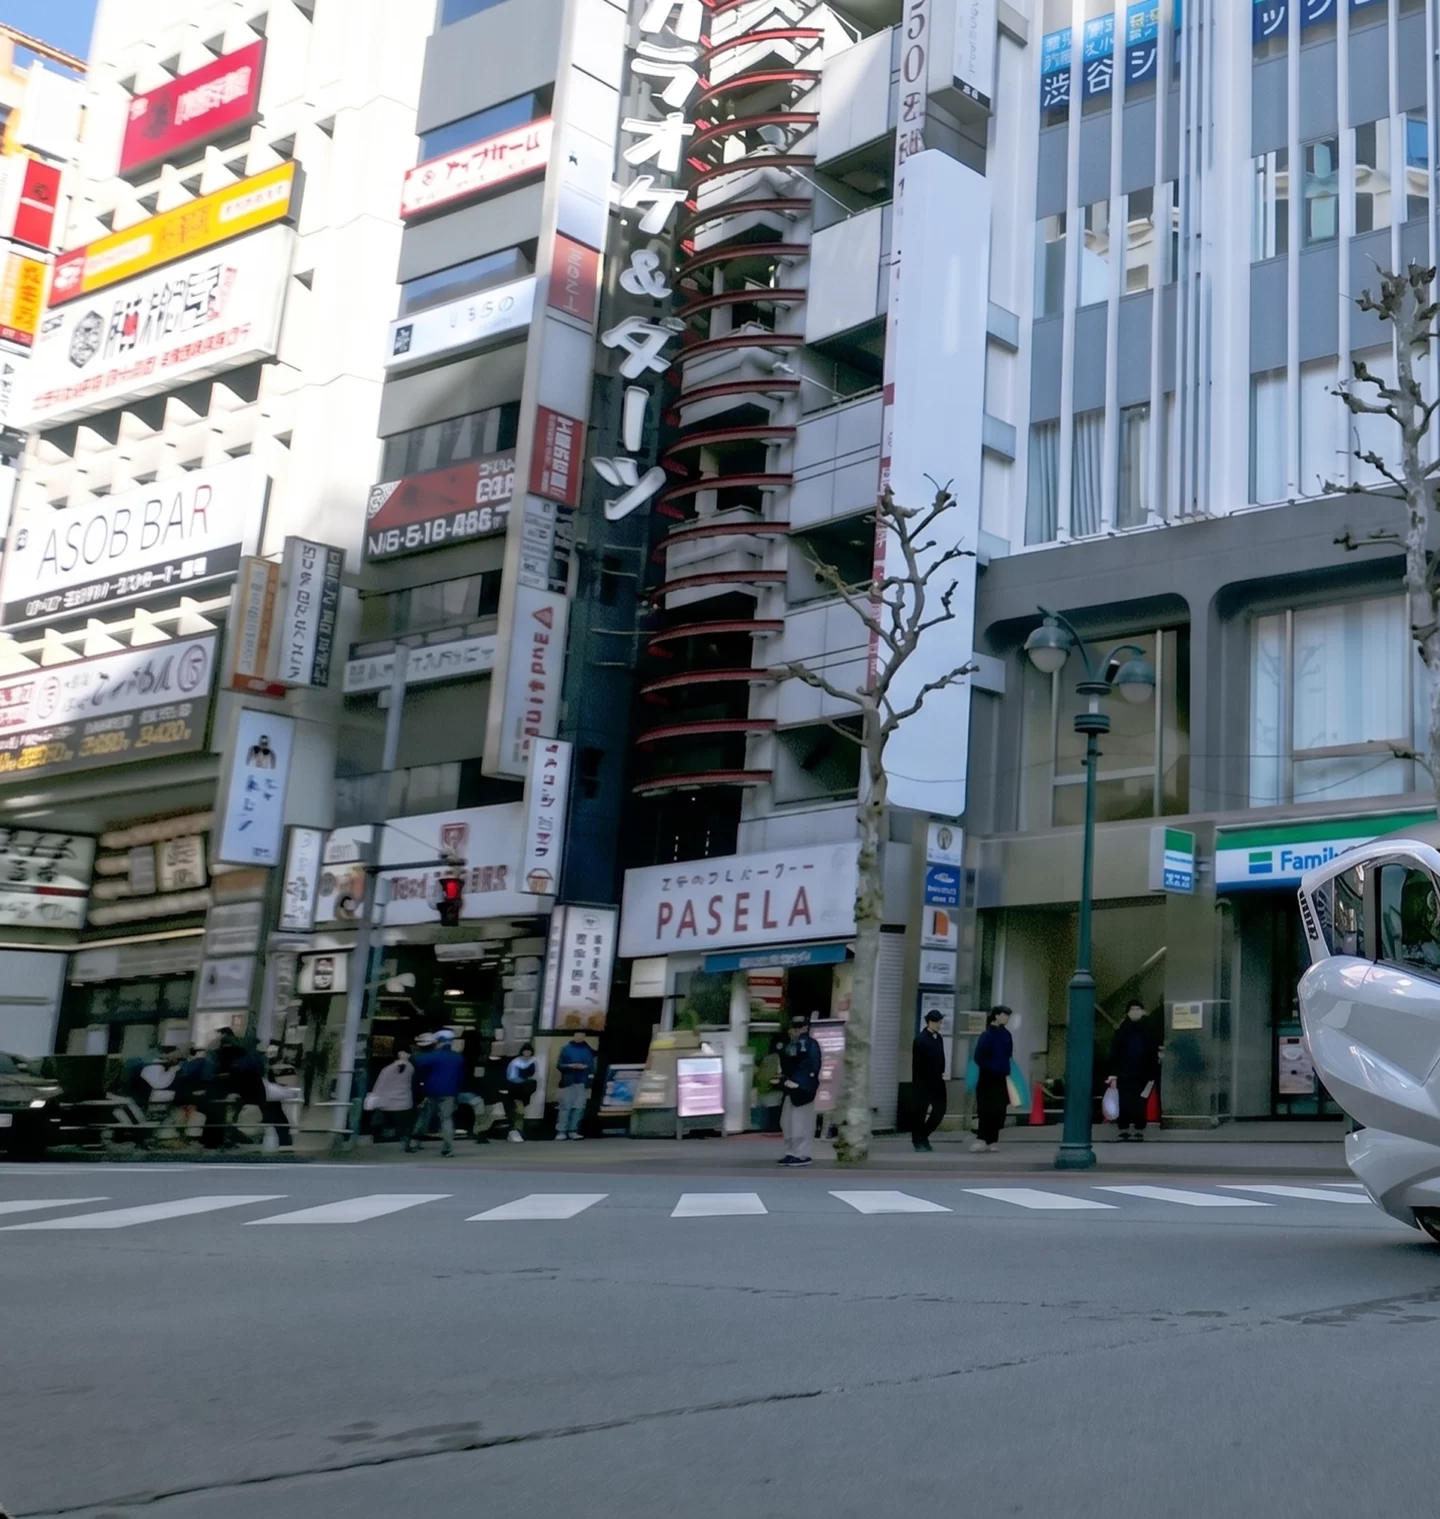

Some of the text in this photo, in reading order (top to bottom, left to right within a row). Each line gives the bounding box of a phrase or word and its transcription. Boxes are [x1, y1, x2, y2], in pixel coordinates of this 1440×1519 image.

[36, 484, 212, 580] ASOB BAR
[1281, 847, 1338, 871] Famil
[656, 885, 812, 939] PASELA
